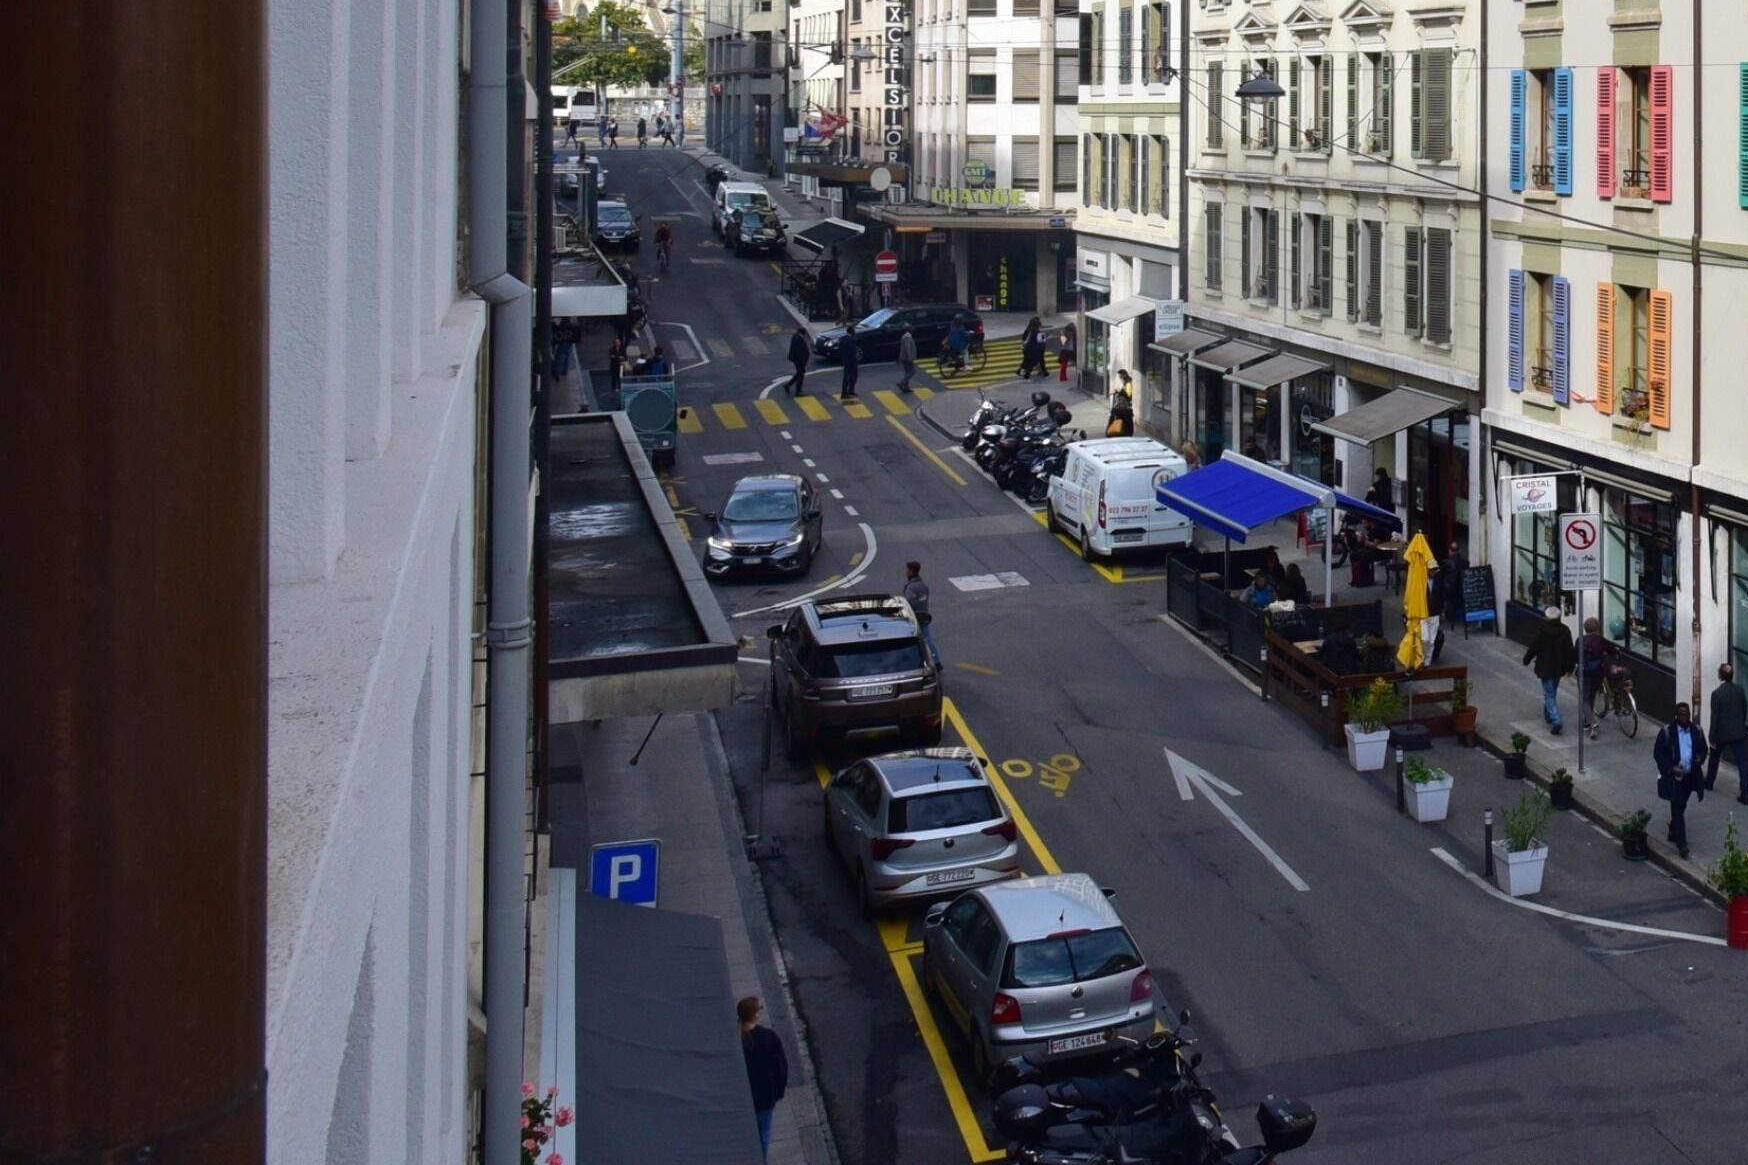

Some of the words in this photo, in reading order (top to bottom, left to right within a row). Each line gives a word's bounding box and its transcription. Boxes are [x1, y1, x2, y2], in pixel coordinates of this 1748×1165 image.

[931, 188, 1026, 205] CHANGE
[1516, 479, 1551, 489] CRISTAL
[1516, 502, 1552, 512] VOYAGES
[610, 854, 641, 900] P
[1059, 1040, 1069, 1051] GE
